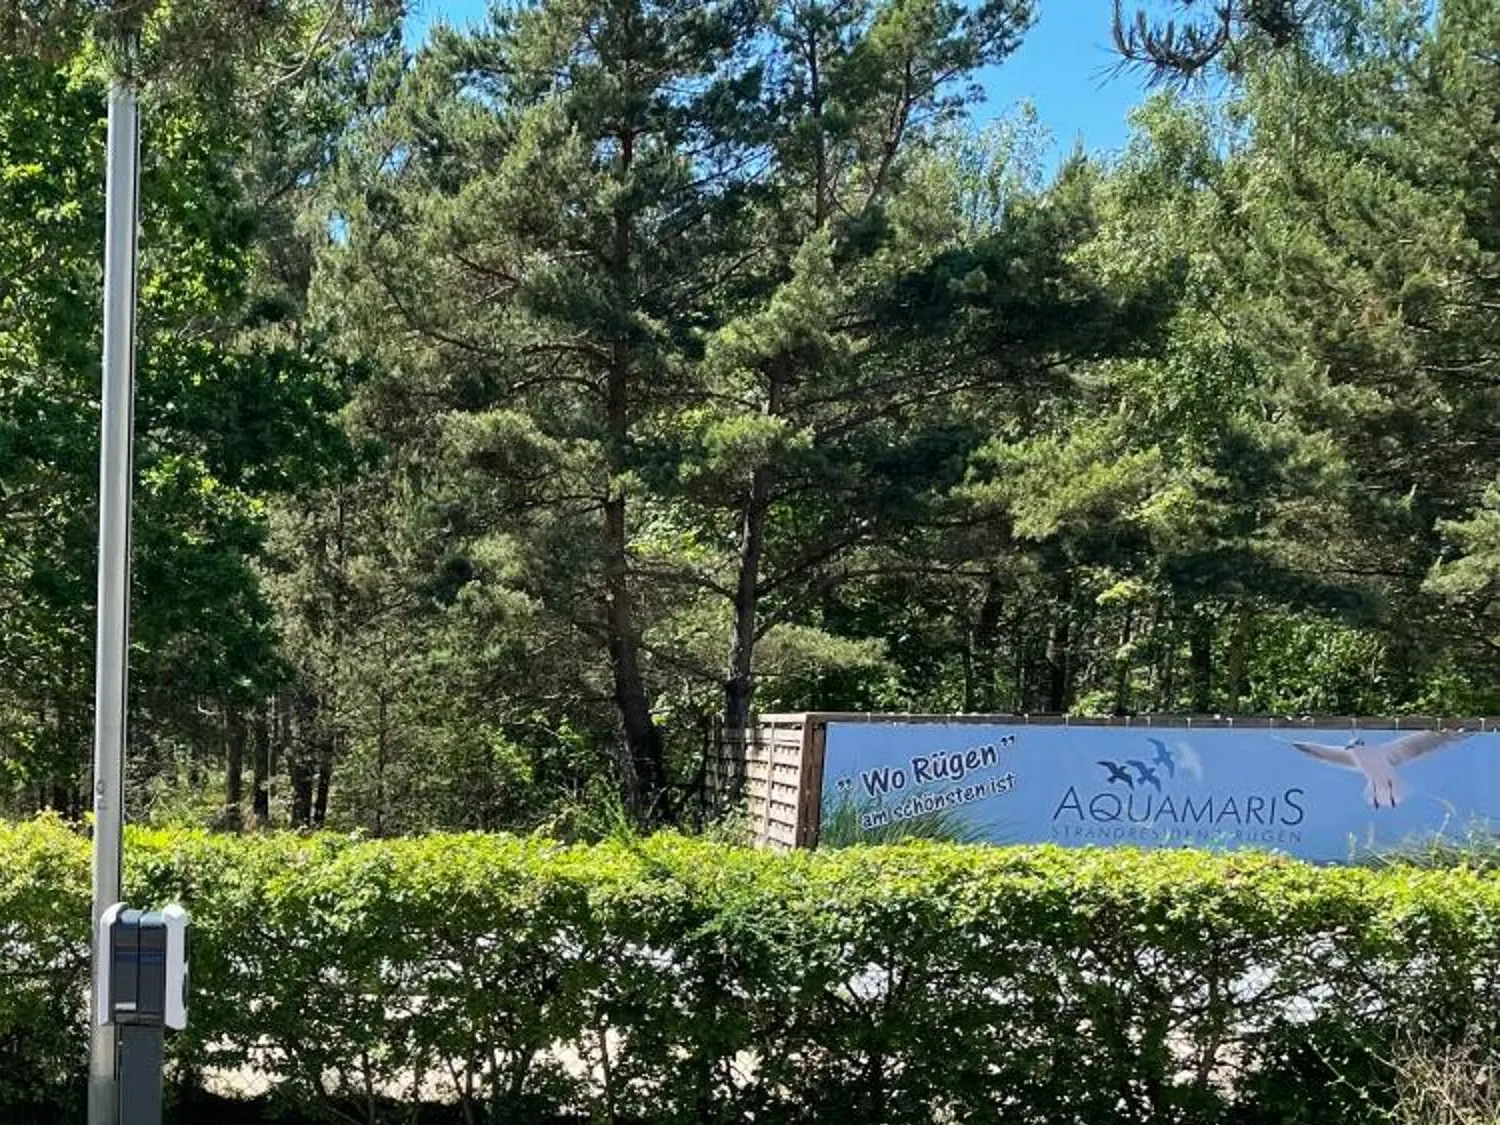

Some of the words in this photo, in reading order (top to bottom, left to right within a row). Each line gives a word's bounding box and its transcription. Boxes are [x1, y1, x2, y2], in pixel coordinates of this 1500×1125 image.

[862, 811, 887, 829] am
[991, 773, 1015, 793] ist
[1053, 785, 1305, 826] AQUAMARIS
